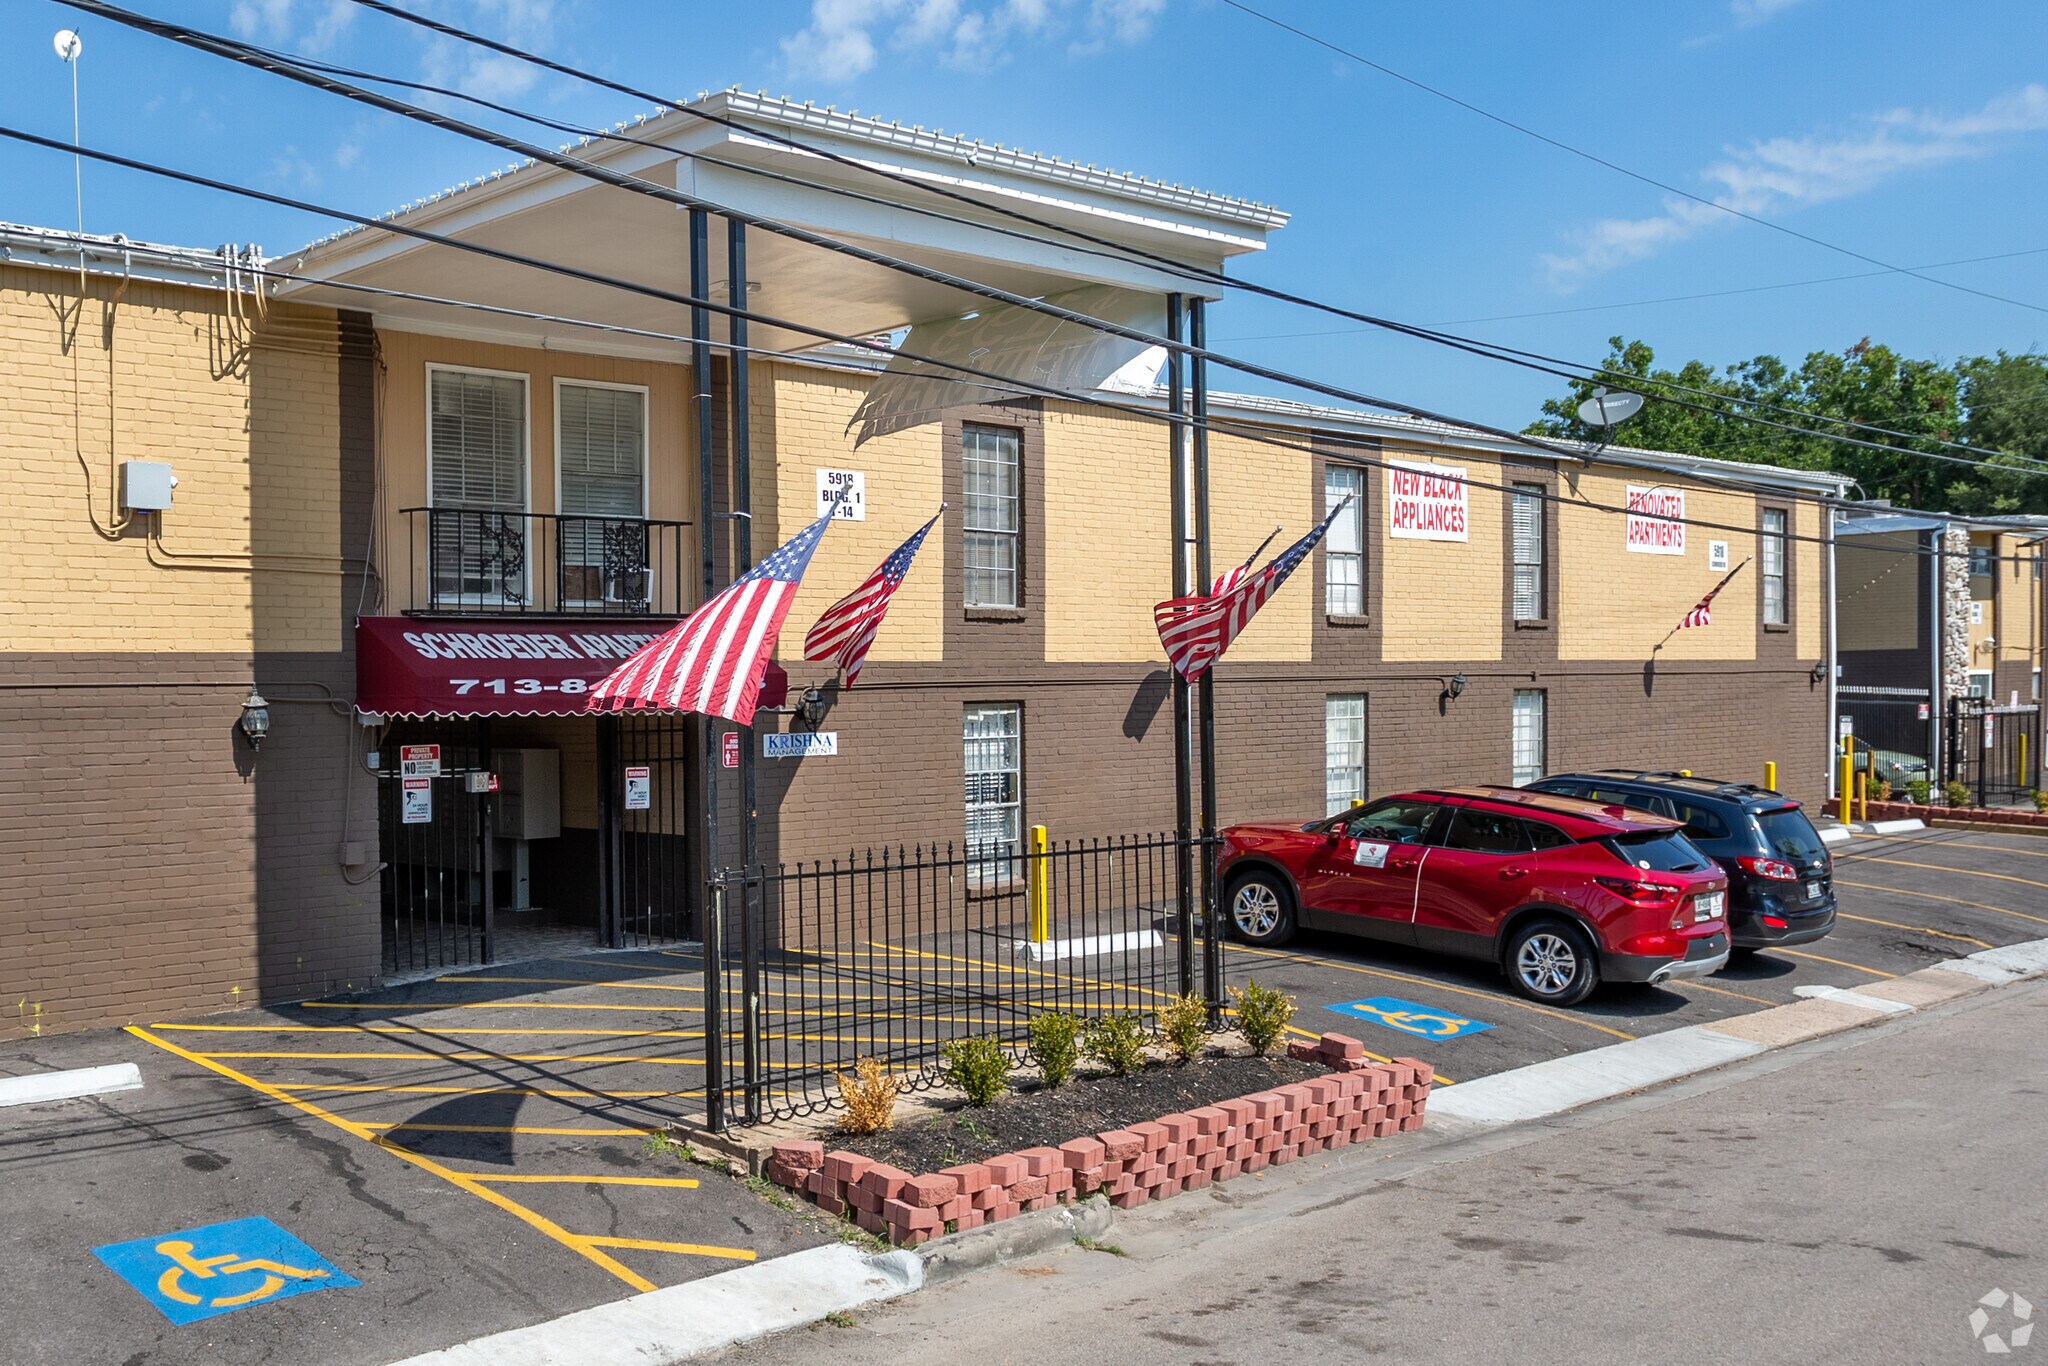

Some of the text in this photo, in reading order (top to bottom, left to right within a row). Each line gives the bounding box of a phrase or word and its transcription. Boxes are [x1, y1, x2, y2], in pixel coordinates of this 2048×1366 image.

[828, 472, 853, 485] 5918
[1393, 468, 1462, 500] NEW BLACK
[855, 492, 860, 504] 1
[1629, 491, 1681, 519] RENOVATED
[1393, 501, 1464, 532] APPLIANCES
[1628, 520, 1683, 548] APARTMENTS
[403, 632, 662, 659] SCHROEDER APART
[449, 678, 589, 694] 713-8
[768, 734, 832, 749] KRISHNA
[404, 761, 416, 775] NO
